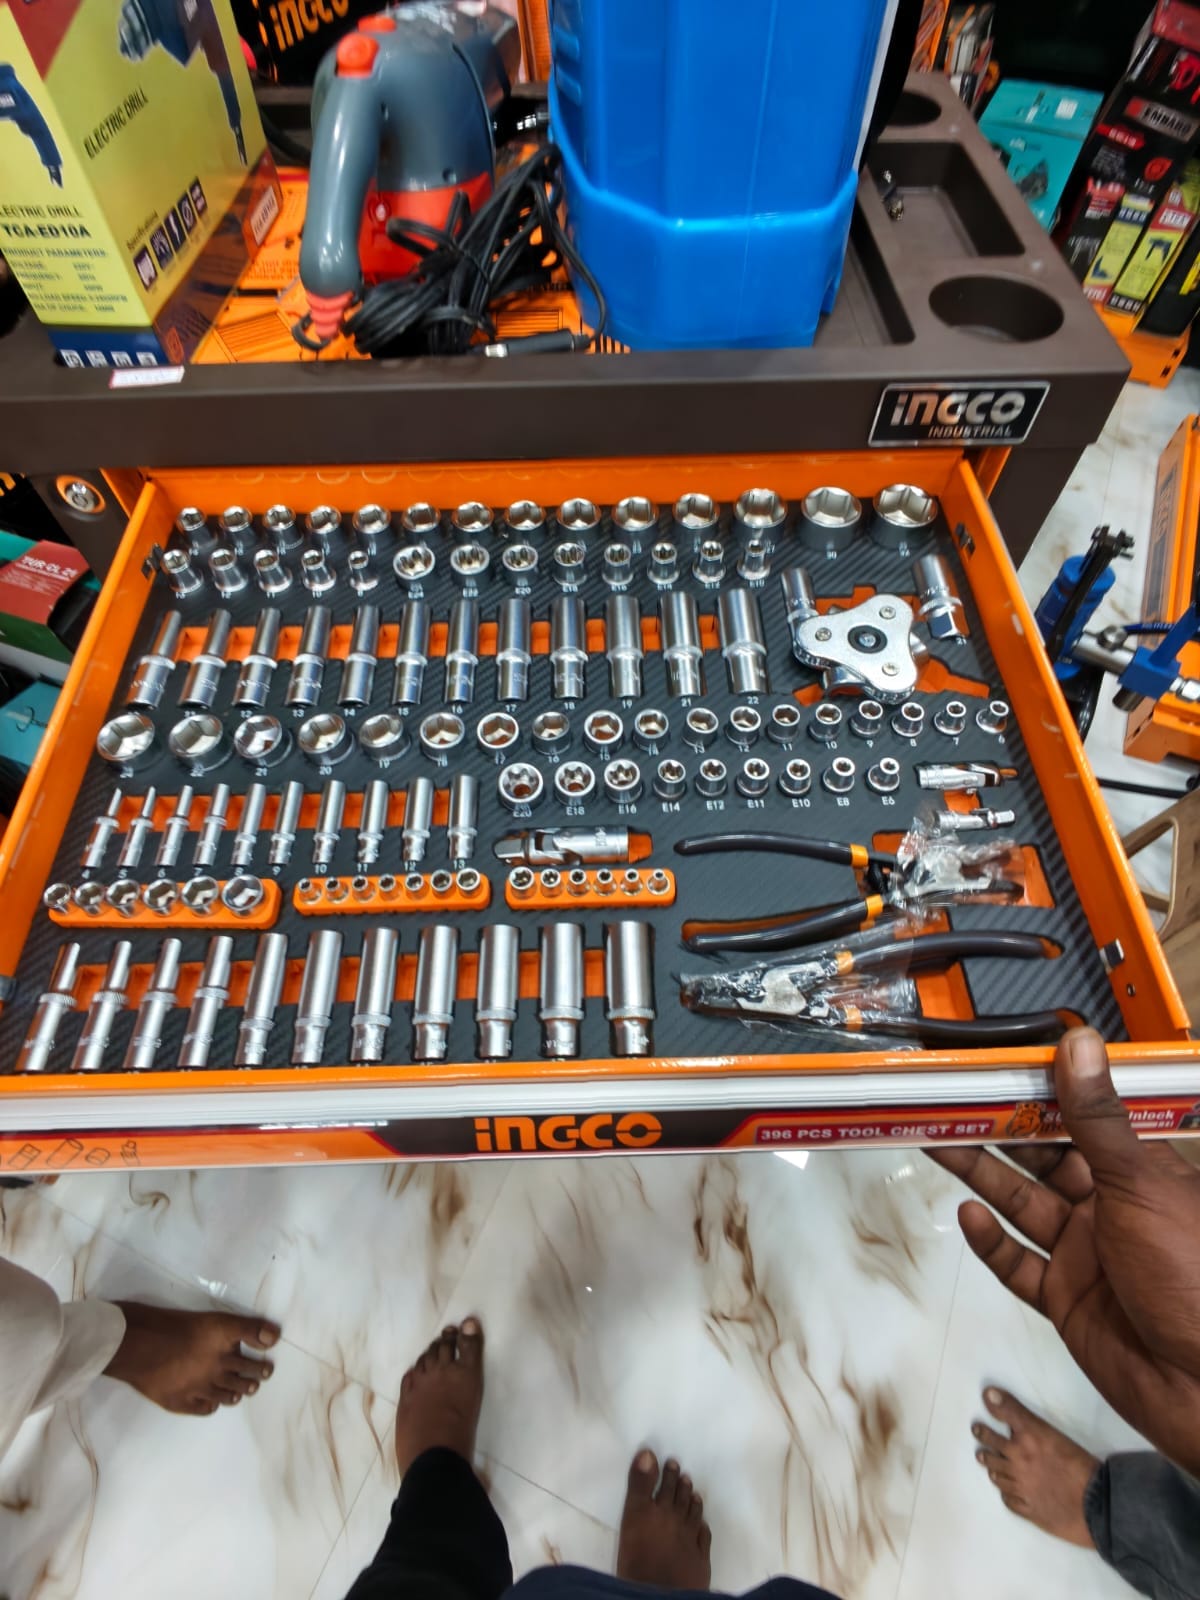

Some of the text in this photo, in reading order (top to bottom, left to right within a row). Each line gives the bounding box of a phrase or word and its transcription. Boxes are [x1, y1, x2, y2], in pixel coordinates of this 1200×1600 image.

[83, 86, 149, 160] ELECTRIC DRILL
[46, 204, 82, 217] DRILL
[928, 426, 1013, 438] INDUSTRIAL
[515, 586, 531, 595] E20
[955, 637, 967, 645] 21
[622, 699, 633, 709] 19
[681, 697, 692, 707] 21
[747, 695, 759, 705] 22
[452, 705, 463, 714] 16
[505, 703, 517, 712] 17
[564, 701, 576, 710] 18
[292, 709, 305, 718] 13
[343, 708, 355, 717] 14
[398, 707, 410, 716] 15
[826, 741, 838, 749] 10
[866, 740, 874, 748] 9
[910, 739, 917, 747] 8
[952, 737, 959, 745] 7
[648, 746, 659, 756] 14
[694, 744, 705, 754] 13
[739, 744, 750, 753] 12
[782, 743, 793, 751] 11
[549, 755, 560, 763] 16
[599, 752, 611, 761] 15
[319, 766, 332, 775] 20
[706, 800, 724, 811] E12
[747, 799, 765, 809] E11
[792, 798, 811, 808] E10
[836, 797, 850, 807] E8
[882, 796, 896, 806] E6
[566, 806, 584, 815] E18
[618, 805, 637, 815] E16
[662, 802, 680, 813] E14
[513, 809, 532, 818] E20
[314, 864, 327, 874] 10
[357, 863, 368, 873] 11
[404, 861, 416, 872] 12
[453, 859, 465, 870] 13
[81, 868, 91, 879] 4
[118, 868, 128, 879] 5
[158, 868, 166, 878] 6
[193, 868, 203, 877] 7
[234, 867, 244, 877] 8
[272, 867, 281, 876] 9
[761, 1123, 990, 1140] 396 PCS TOOL CHEST SET
